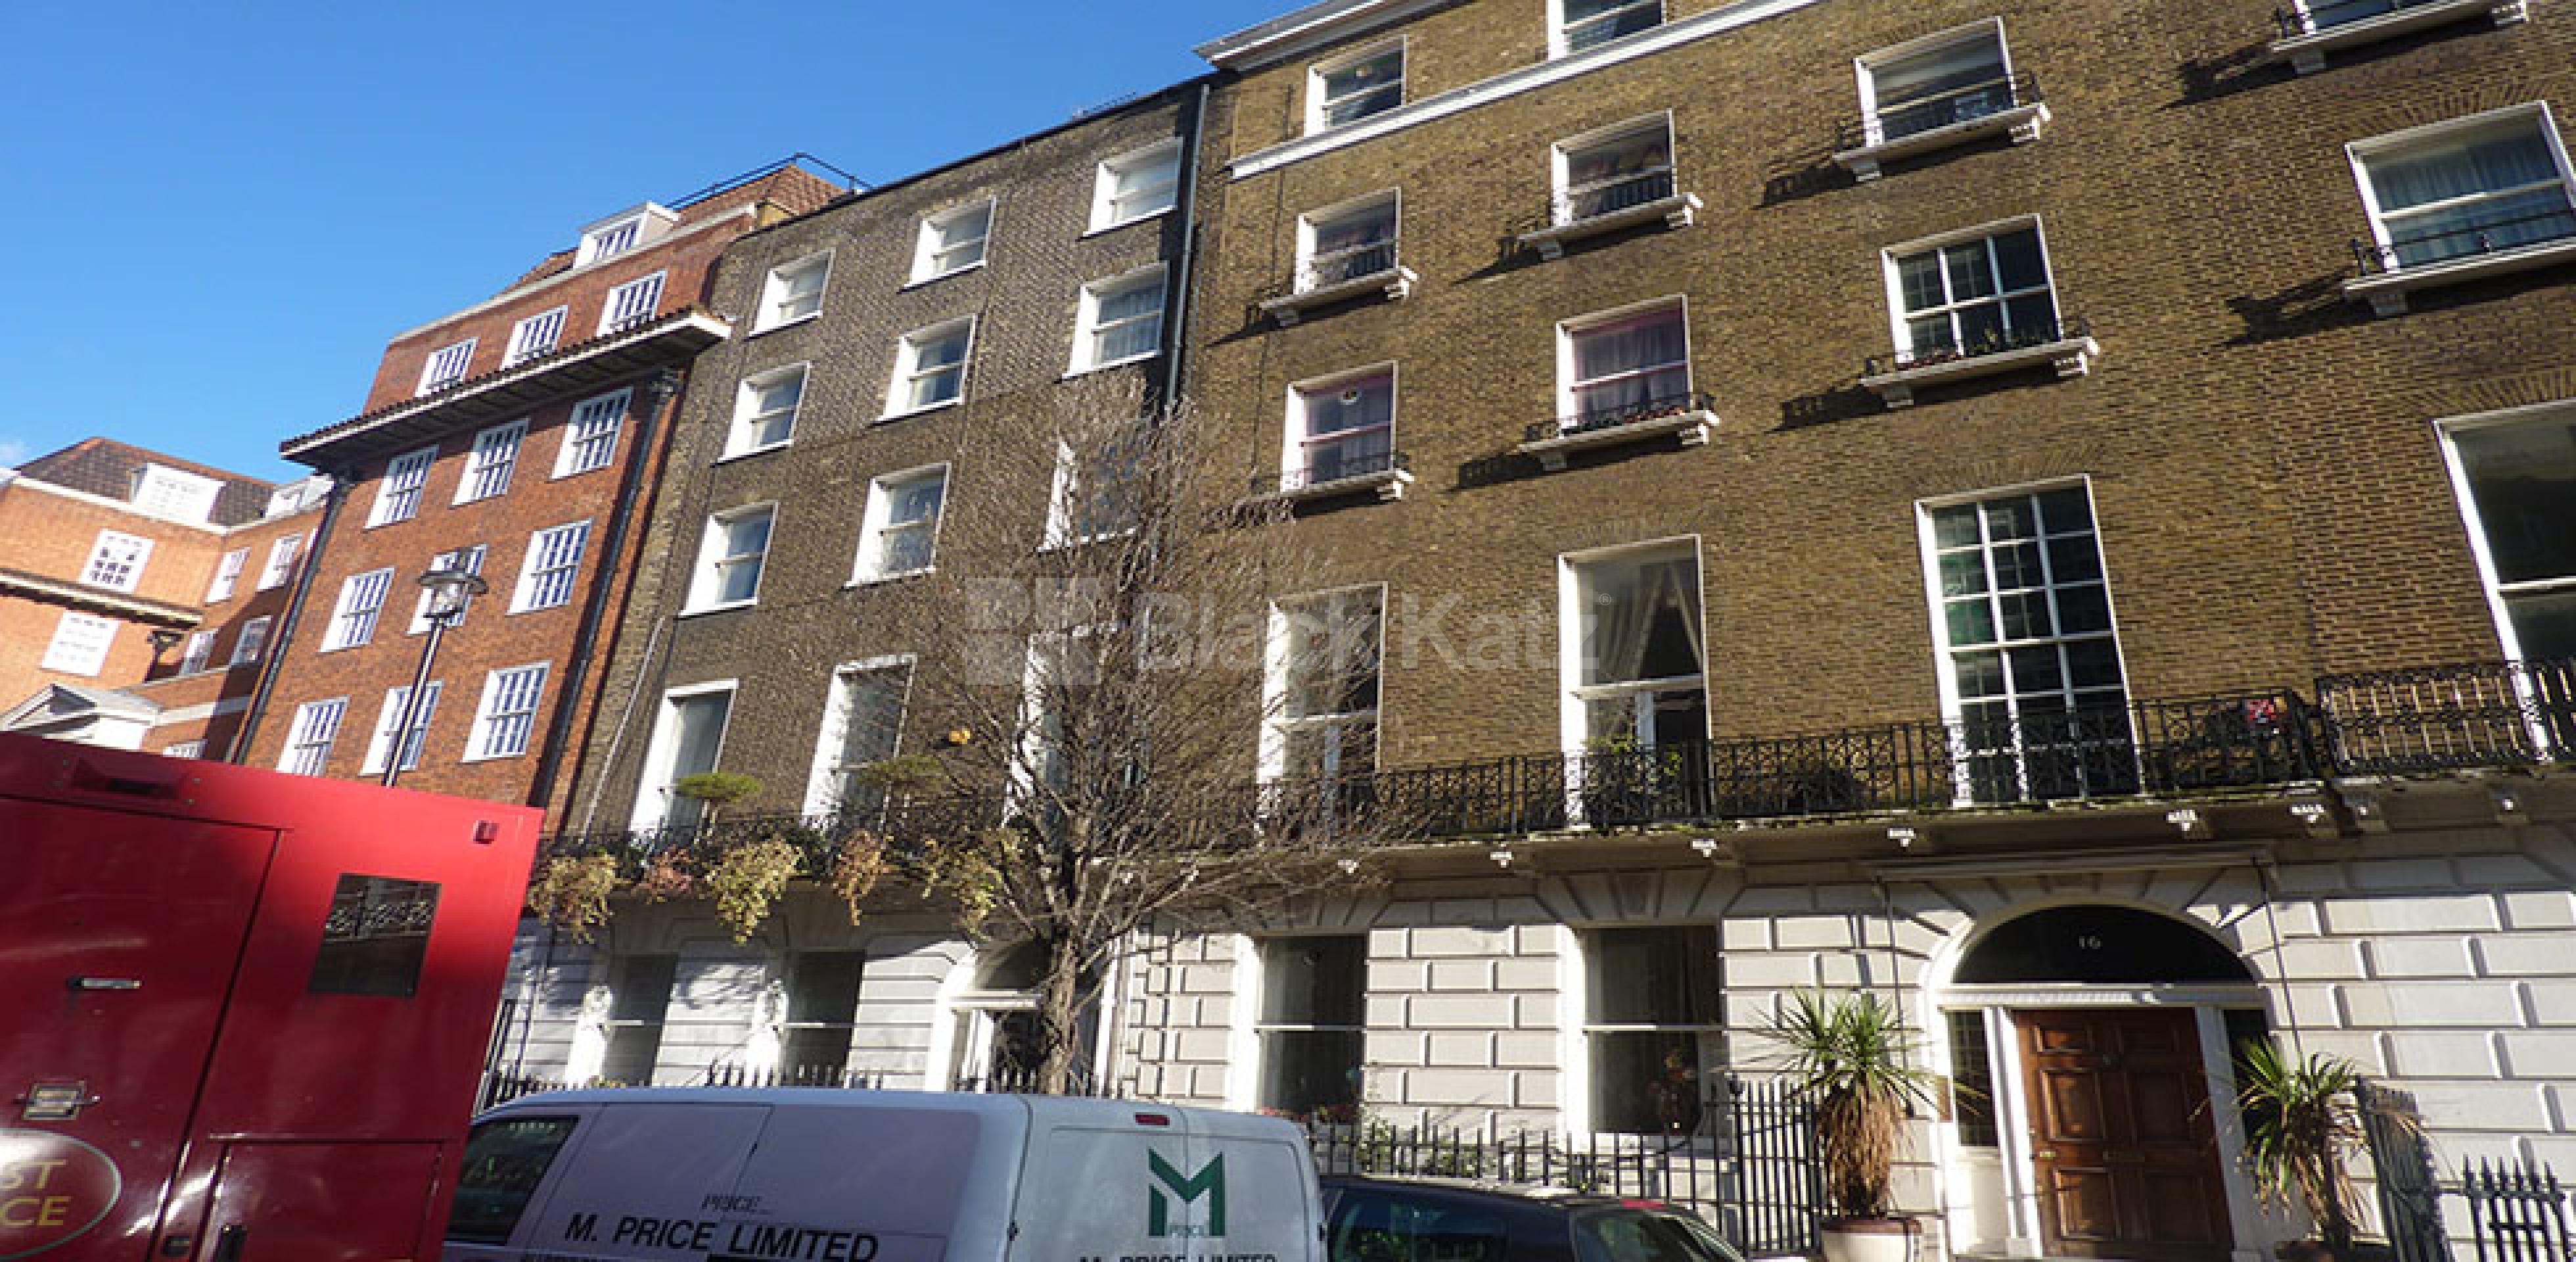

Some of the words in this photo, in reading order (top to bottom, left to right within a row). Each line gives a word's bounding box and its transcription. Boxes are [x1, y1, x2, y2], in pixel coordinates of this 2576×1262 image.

[2079, 935, 2101, 949] 16
[564, 1213, 597, 1242] M.
[612, 1217, 716, 1250] PRICE
[729, 1225, 879, 1262] LIMITED
